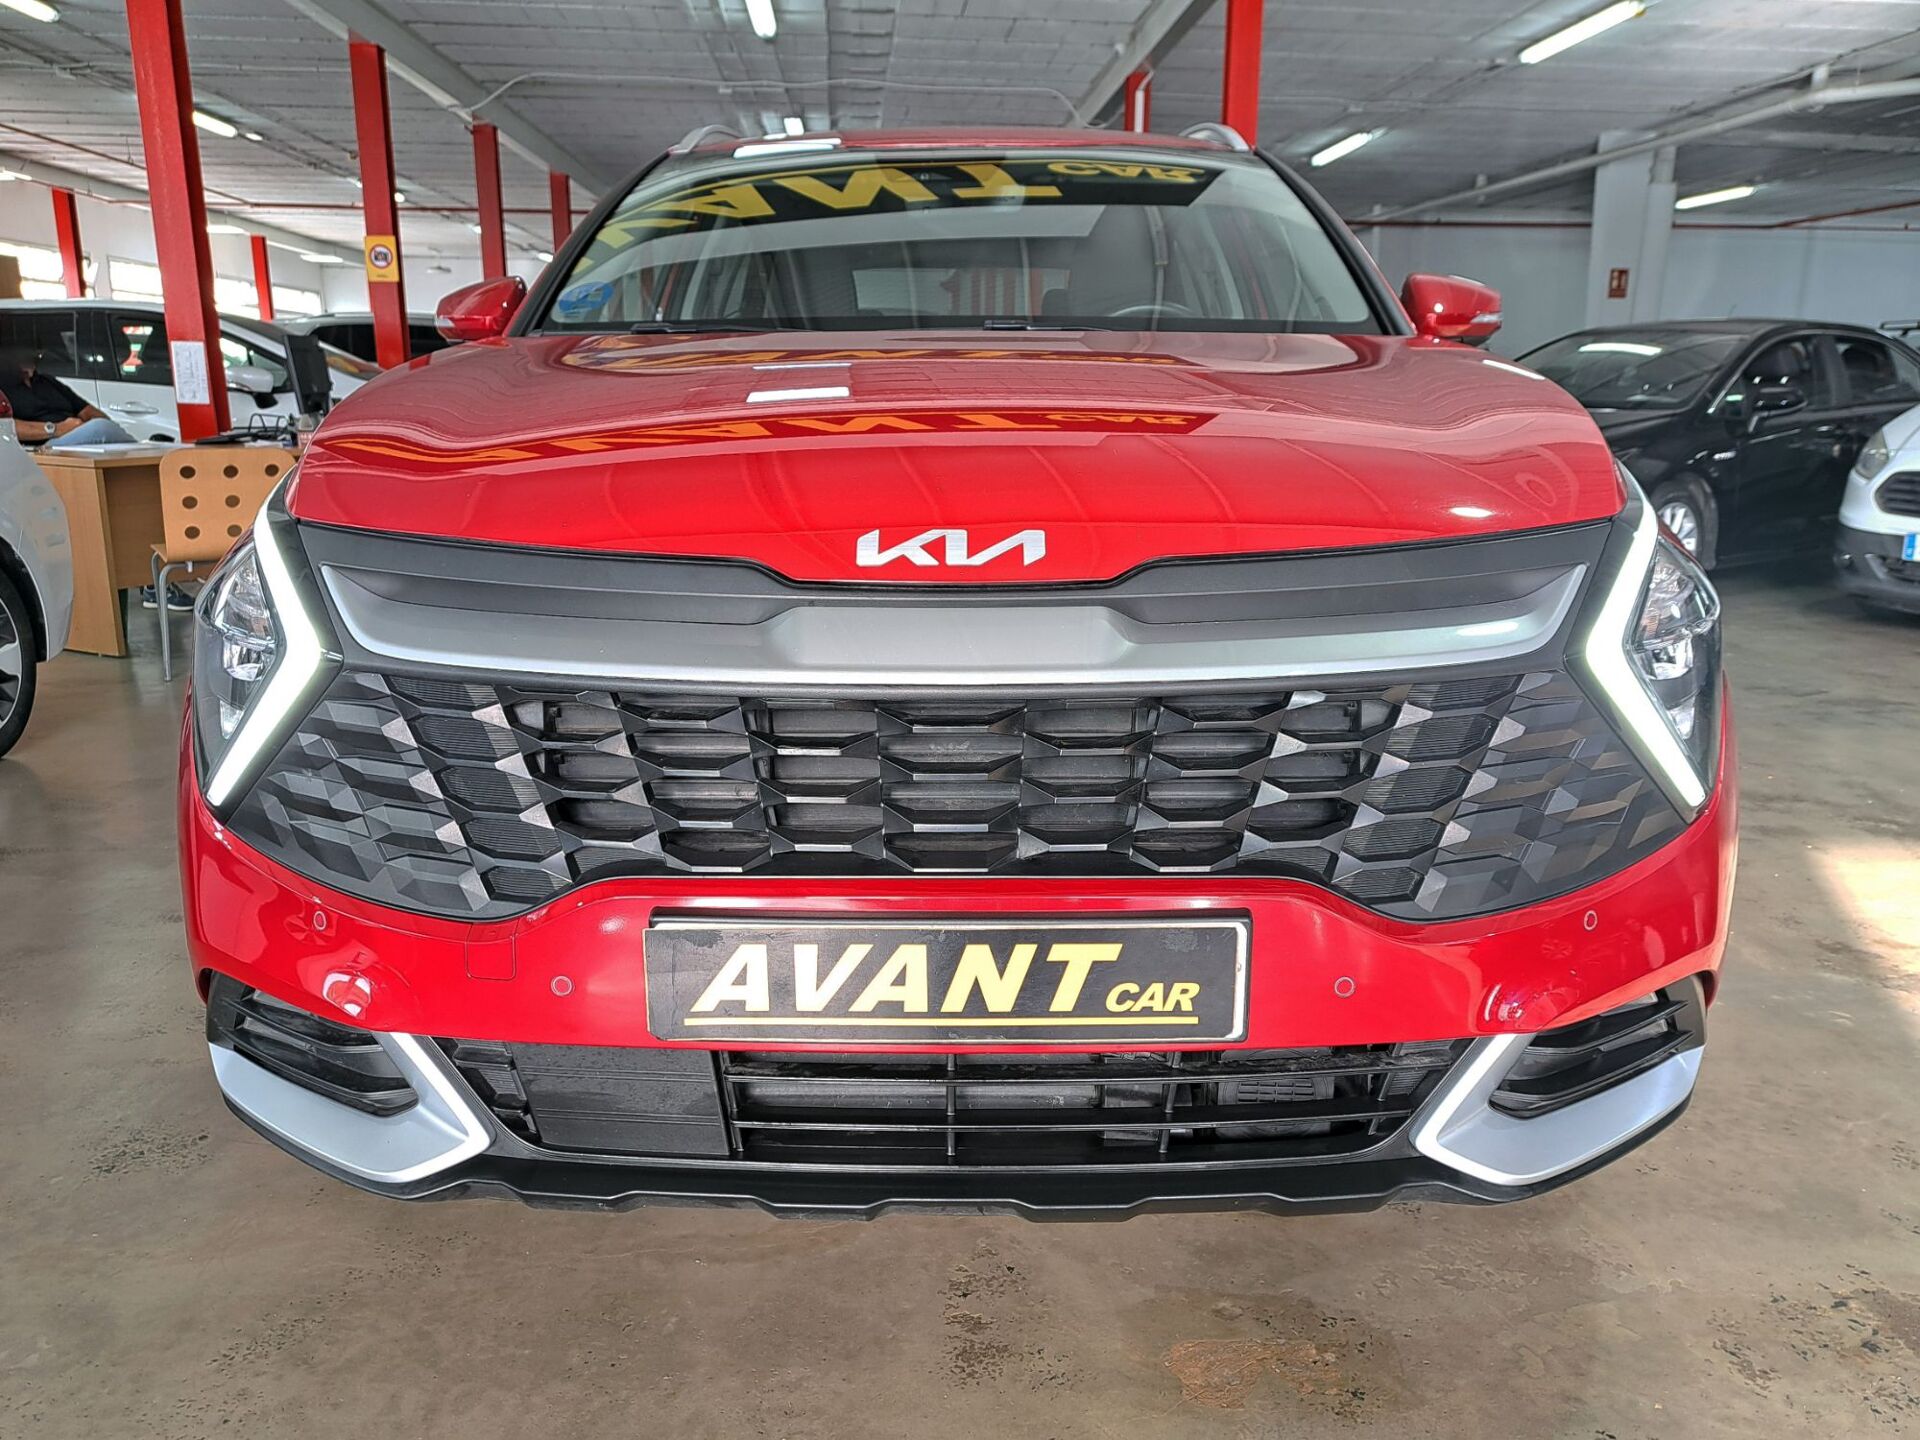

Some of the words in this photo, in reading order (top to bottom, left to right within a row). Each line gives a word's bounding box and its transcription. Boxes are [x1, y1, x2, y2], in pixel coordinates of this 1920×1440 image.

[856, 528, 1046, 567] KIA
[689, 943, 1123, 1013] AVANT
[1105, 982, 1200, 1013] CAR
